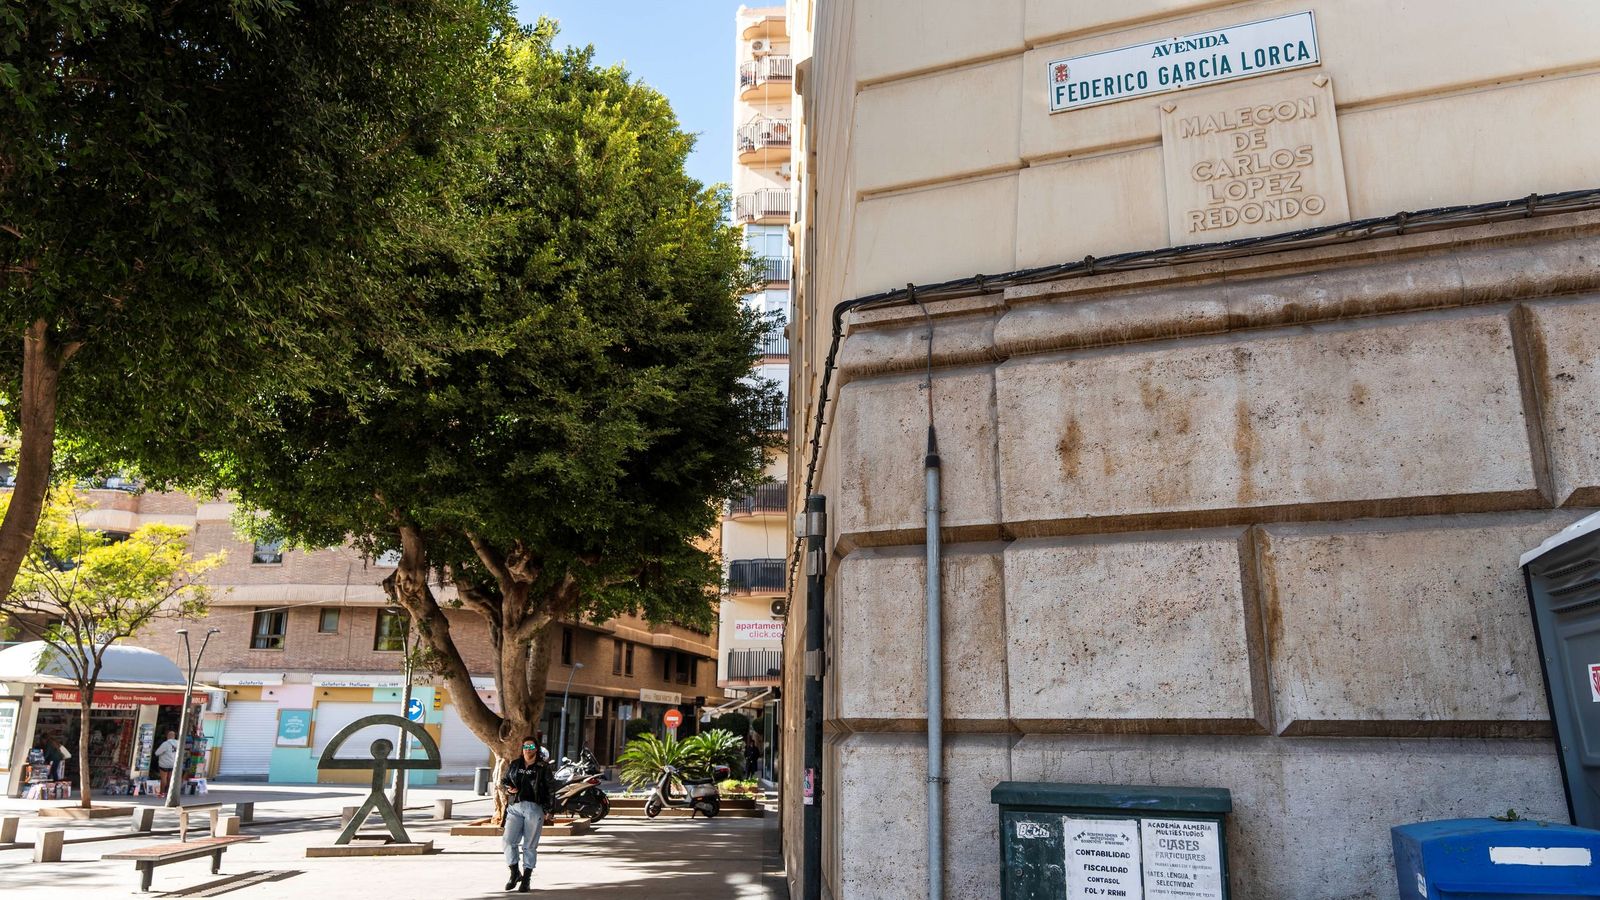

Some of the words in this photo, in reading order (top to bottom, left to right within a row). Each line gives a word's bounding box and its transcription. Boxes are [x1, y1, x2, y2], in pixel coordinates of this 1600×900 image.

[1151, 33, 1230, 58] AVENIDA
[1055, 70, 1148, 105] FEDERICO
[1158, 53, 1232, 86] GARCÍA
[1241, 40, 1311, 71] LORCA
[1179, 96, 1316, 139] MALECON
[1233, 128, 1267, 153] DE
[1190, 145, 1314, 182] CARLOS
[1206, 171, 1303, 205] LOPEZ
[1187, 194, 1326, 233] REDONDO
[191, 695, 207, 704] HOLA!
[1075, 848, 1131, 859] CONTABILIDAD
[1158, 838, 1200, 851] CLASES
[1155, 851, 1206, 861] PARTICULARES
[1083, 863, 1129, 874] FISCALIDAD
[1087, 876, 1120, 885] CONTASOL
[1107, 889, 1127, 897] RRHH
